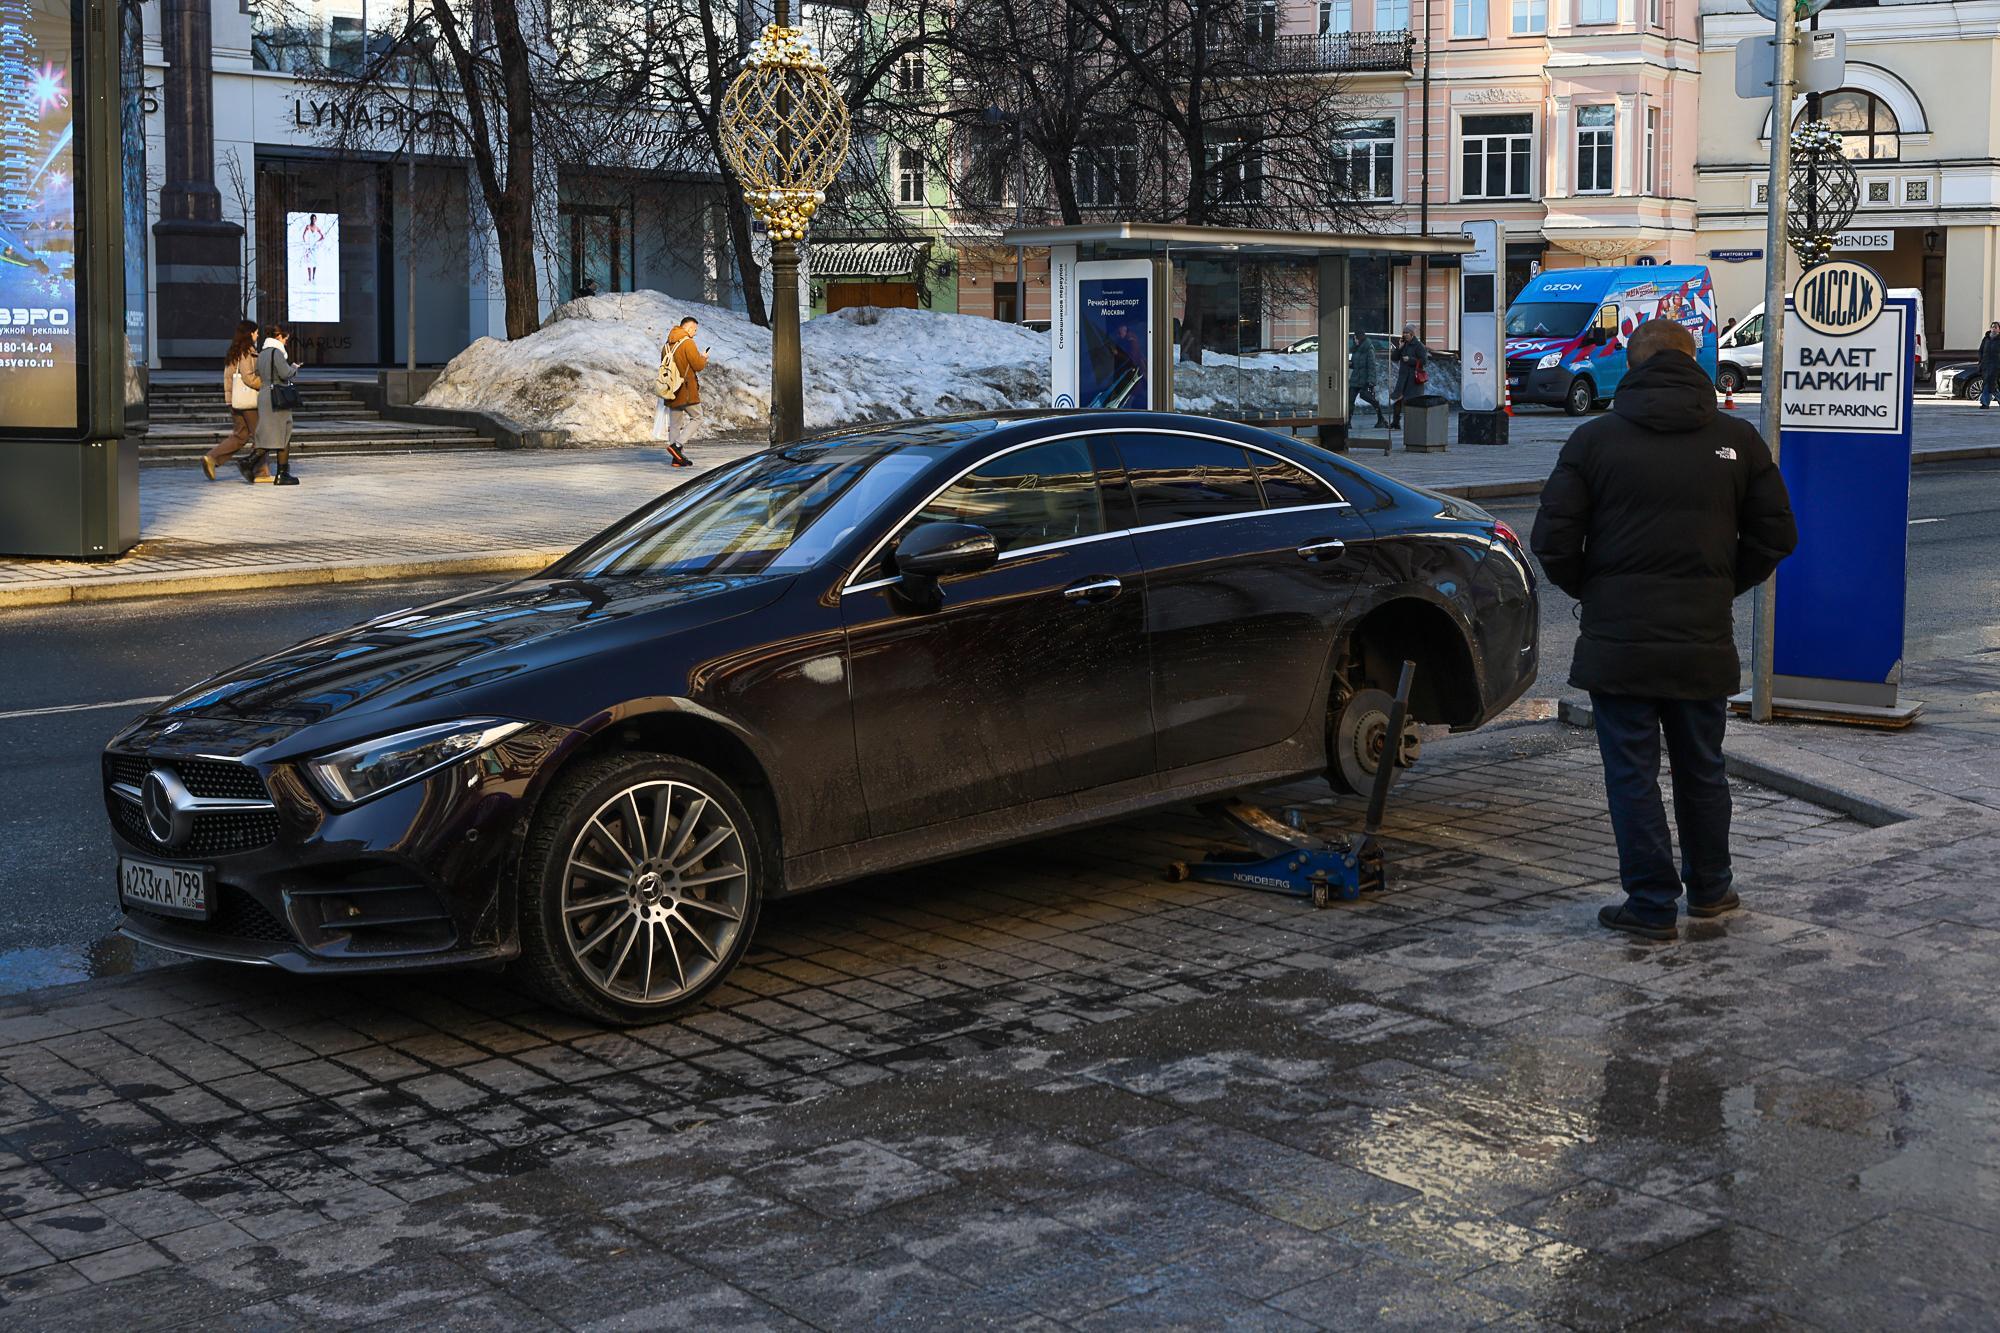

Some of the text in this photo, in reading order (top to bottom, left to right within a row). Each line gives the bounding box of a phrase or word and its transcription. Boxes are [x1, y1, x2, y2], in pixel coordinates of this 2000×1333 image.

[296, 99, 373, 131] LYNA
[1836, 235, 1888, 247] BENDES
[1109, 299, 1139, 307] транспорт
[1803, 270, 1873, 326] ПАССАЖ
[32, 327, 70, 336] рекламы
[1505, 343, 1546, 351] ZON
[1800, 347, 1876, 367] ВАЛЕТ
[1783, 371, 1892, 391] ПАРКИНГ
[1784, 403, 1888, 417] VALET PARKING
[174, 871, 200, 898] 799
[1233, 873, 1290, 888] NORDBERG
[182, 897, 196, 907] RUS
